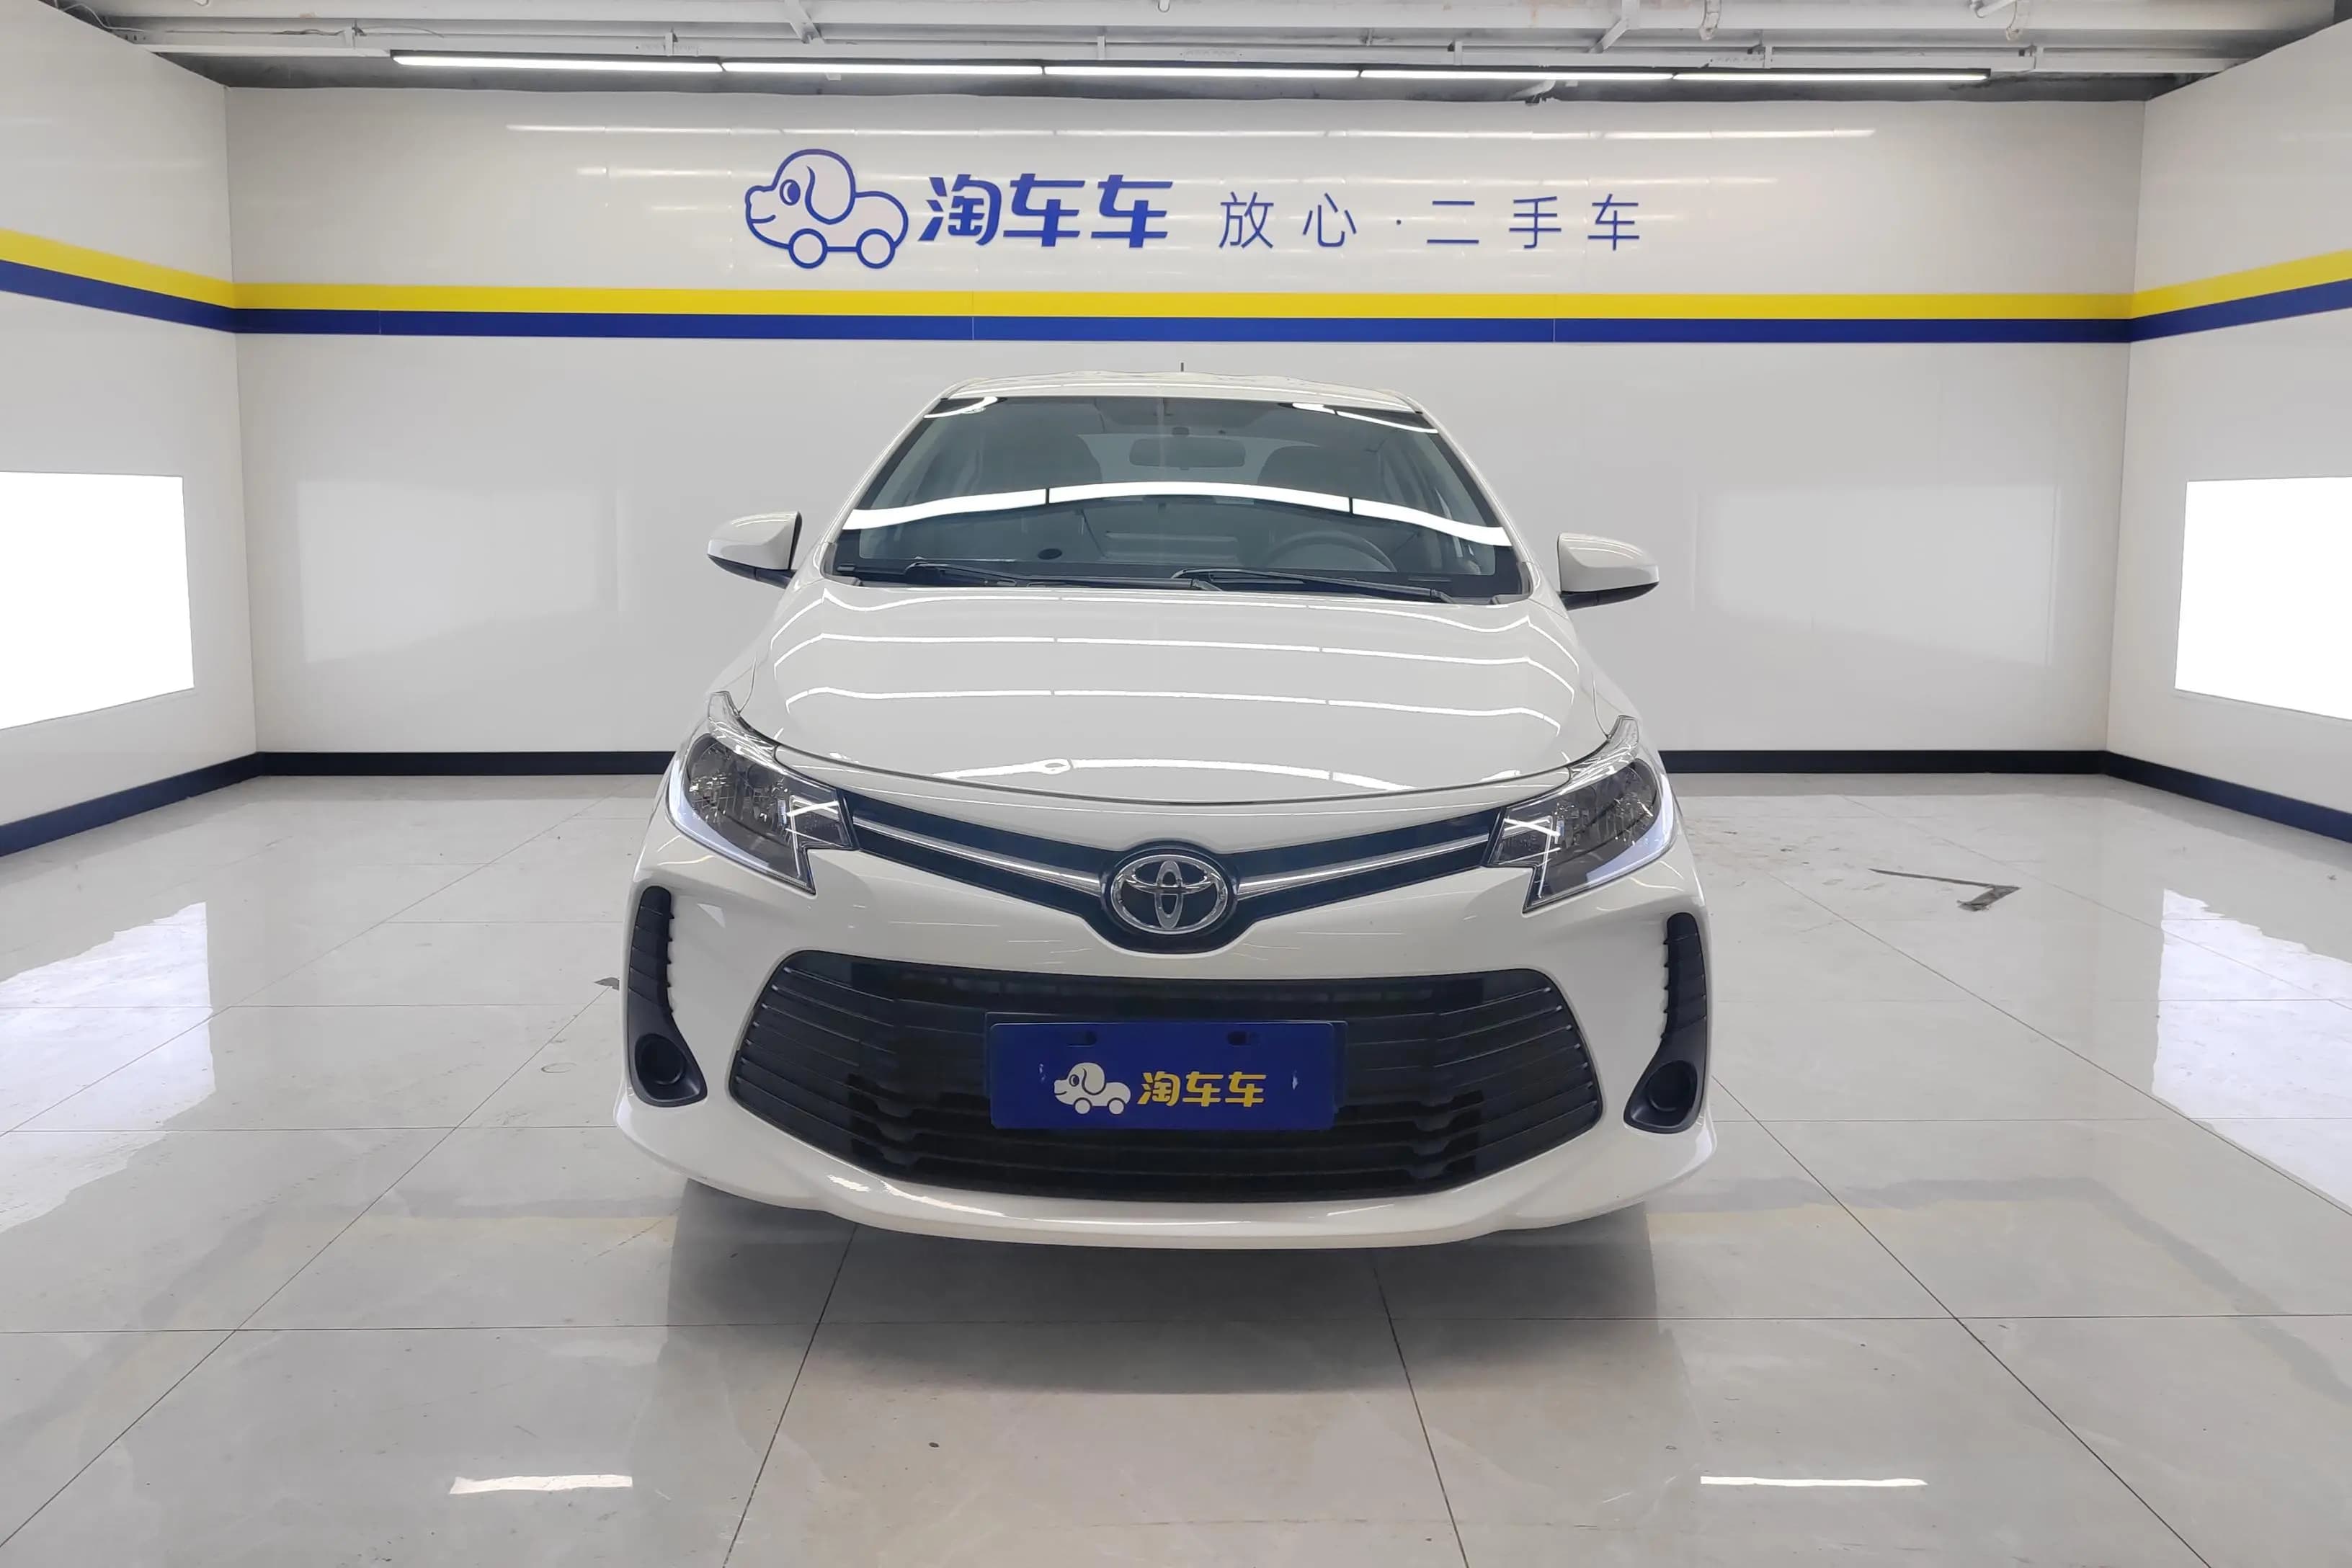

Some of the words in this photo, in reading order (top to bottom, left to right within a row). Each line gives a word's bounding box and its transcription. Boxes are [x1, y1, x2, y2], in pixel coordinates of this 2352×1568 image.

[917, 172, 1173, 249] 淘车车
[1137, 1071, 1266, 1108] 淘车车
